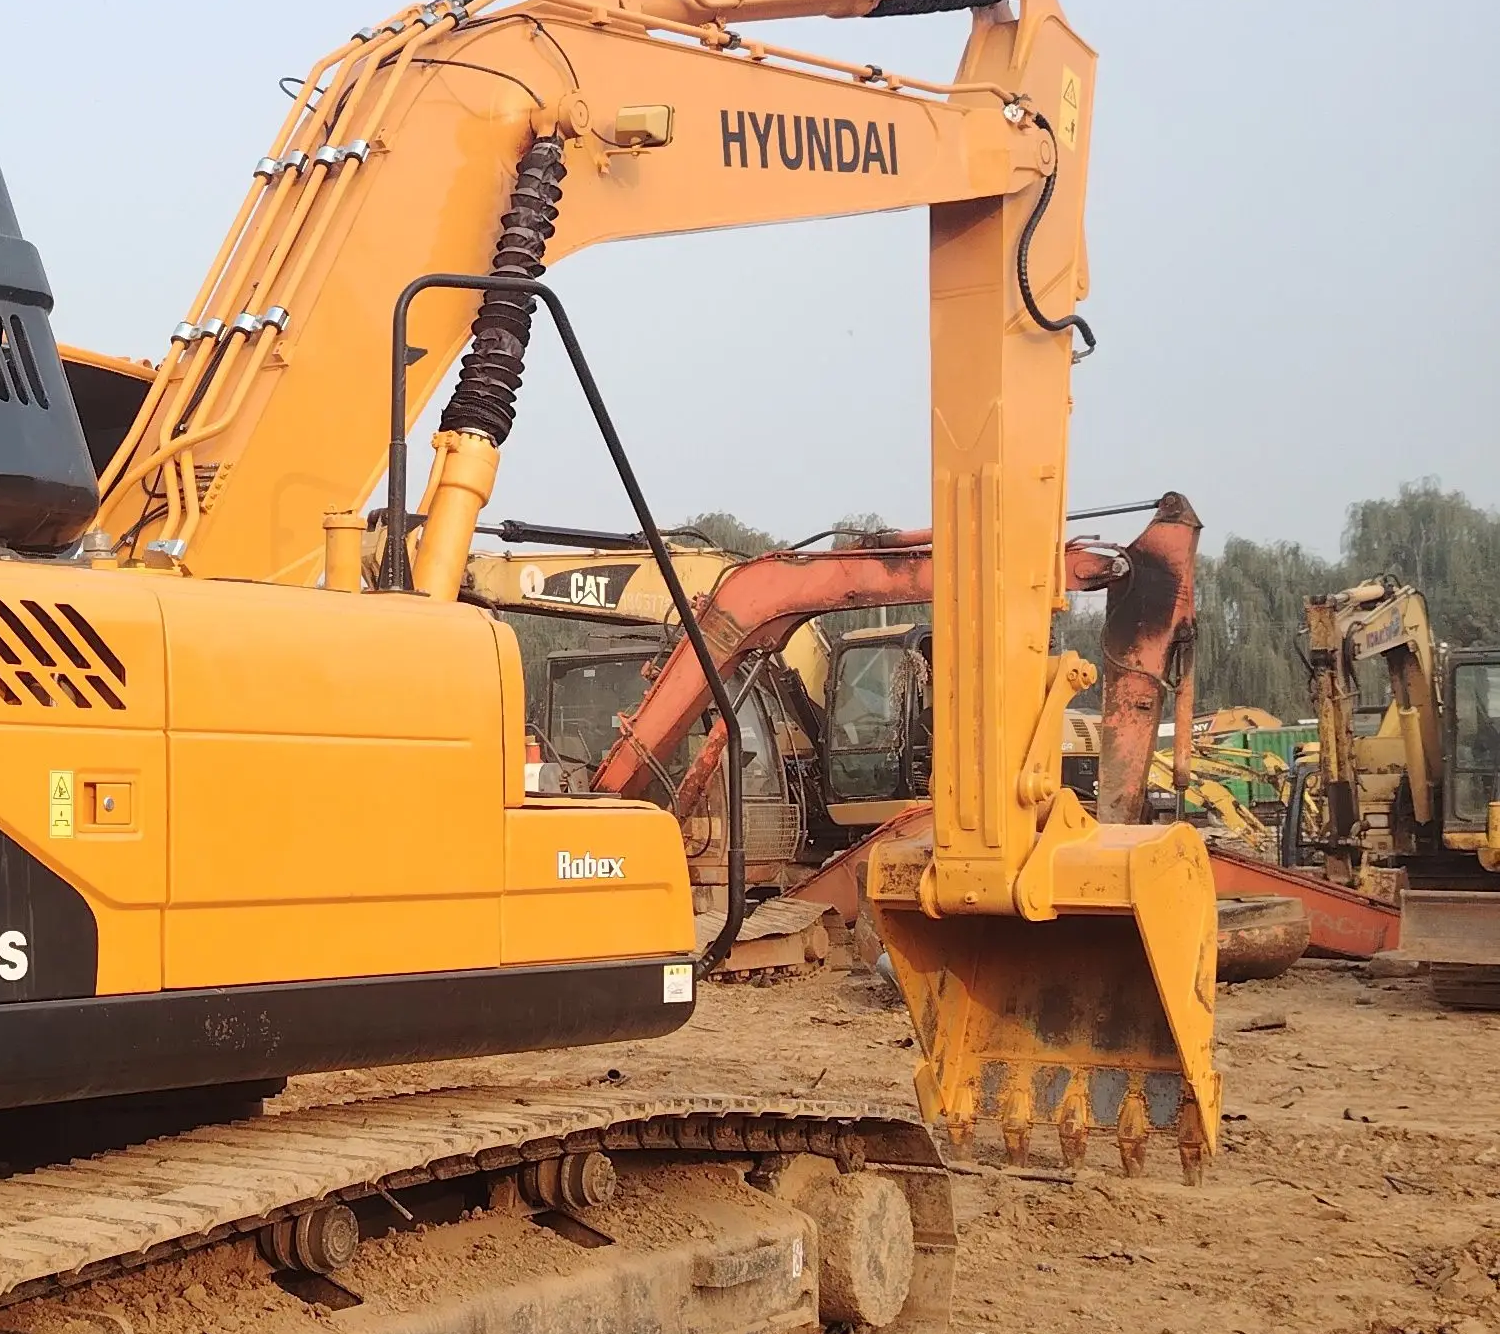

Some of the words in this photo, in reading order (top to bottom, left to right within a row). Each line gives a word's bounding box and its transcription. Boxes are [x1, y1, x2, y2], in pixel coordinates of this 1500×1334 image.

[720, 110, 898, 175] HYUNDAI
[571, 572, 610, 607] CAT
[557, 851, 626, 879] Robex
